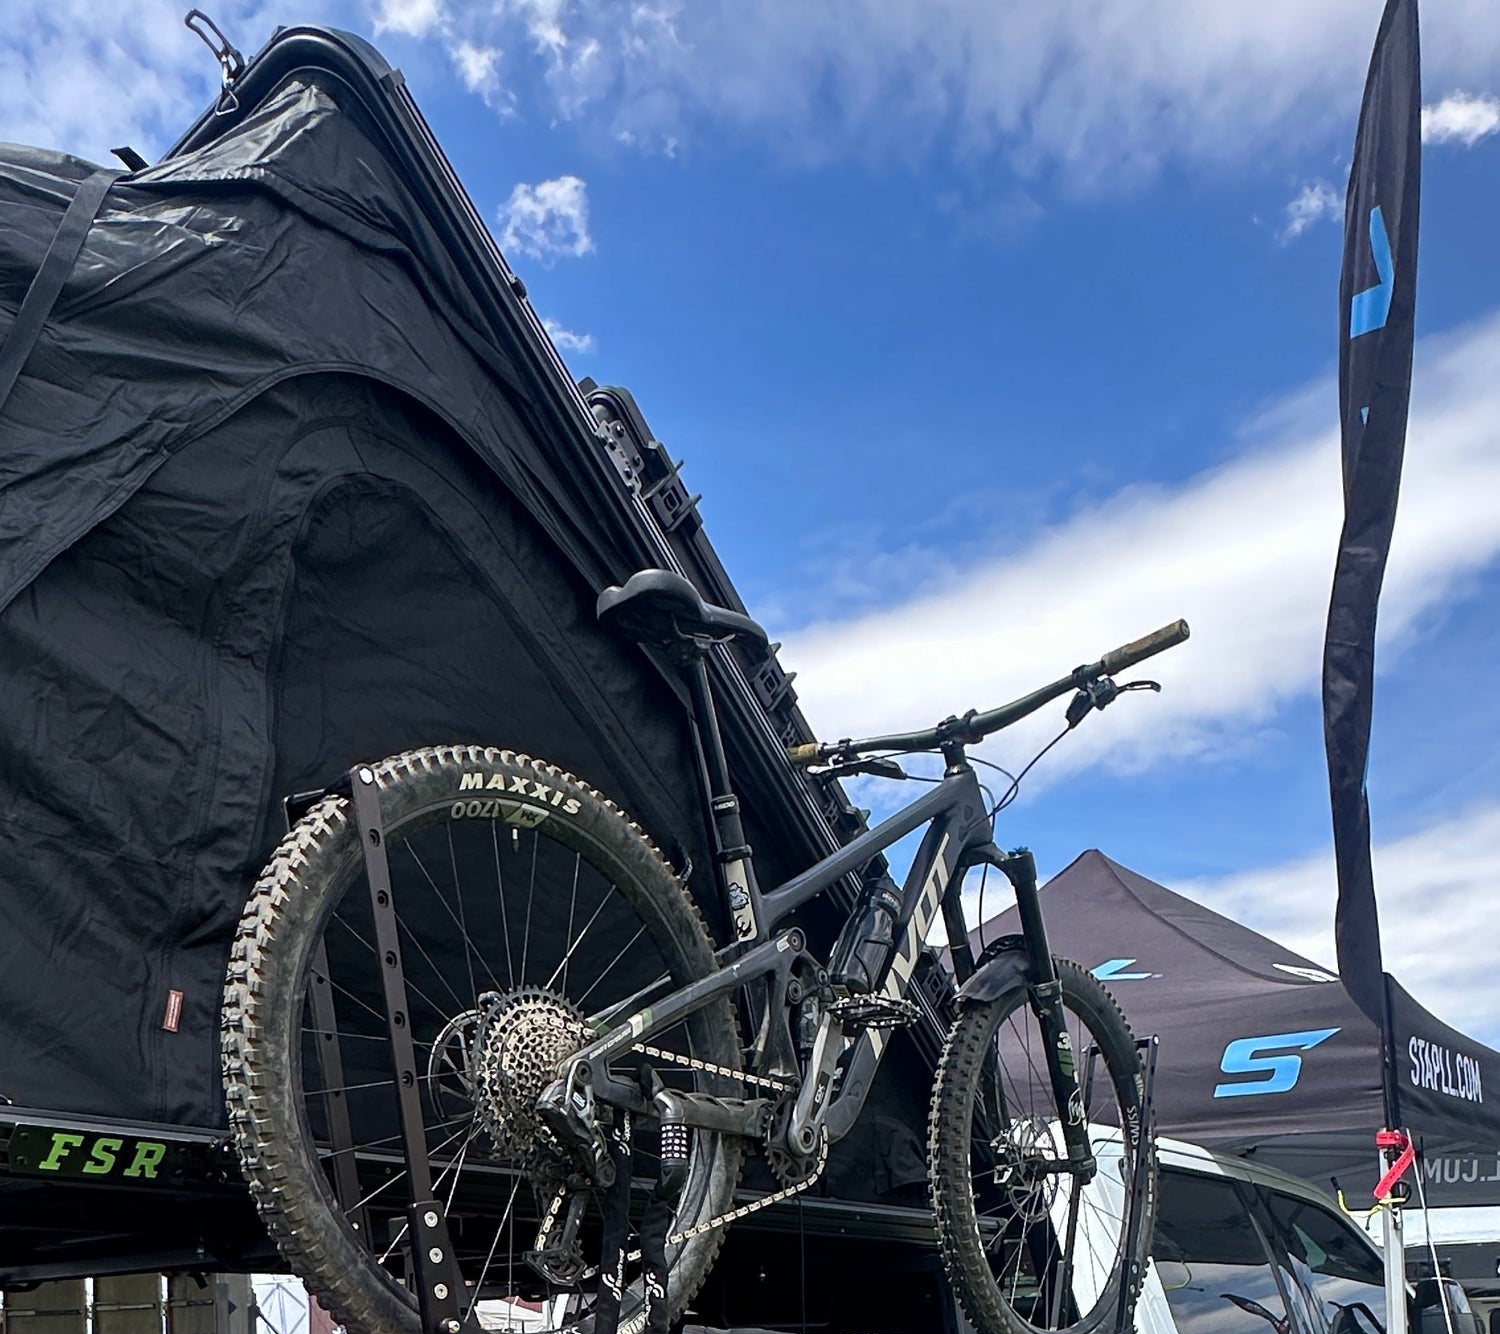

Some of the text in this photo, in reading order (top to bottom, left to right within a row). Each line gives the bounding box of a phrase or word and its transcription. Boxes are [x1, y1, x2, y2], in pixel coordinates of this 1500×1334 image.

[459, 773, 582, 815] MAXXIS
[1408, 1035, 1483, 1104] STAPLL.COM
[38, 1132, 167, 1178] FSR
